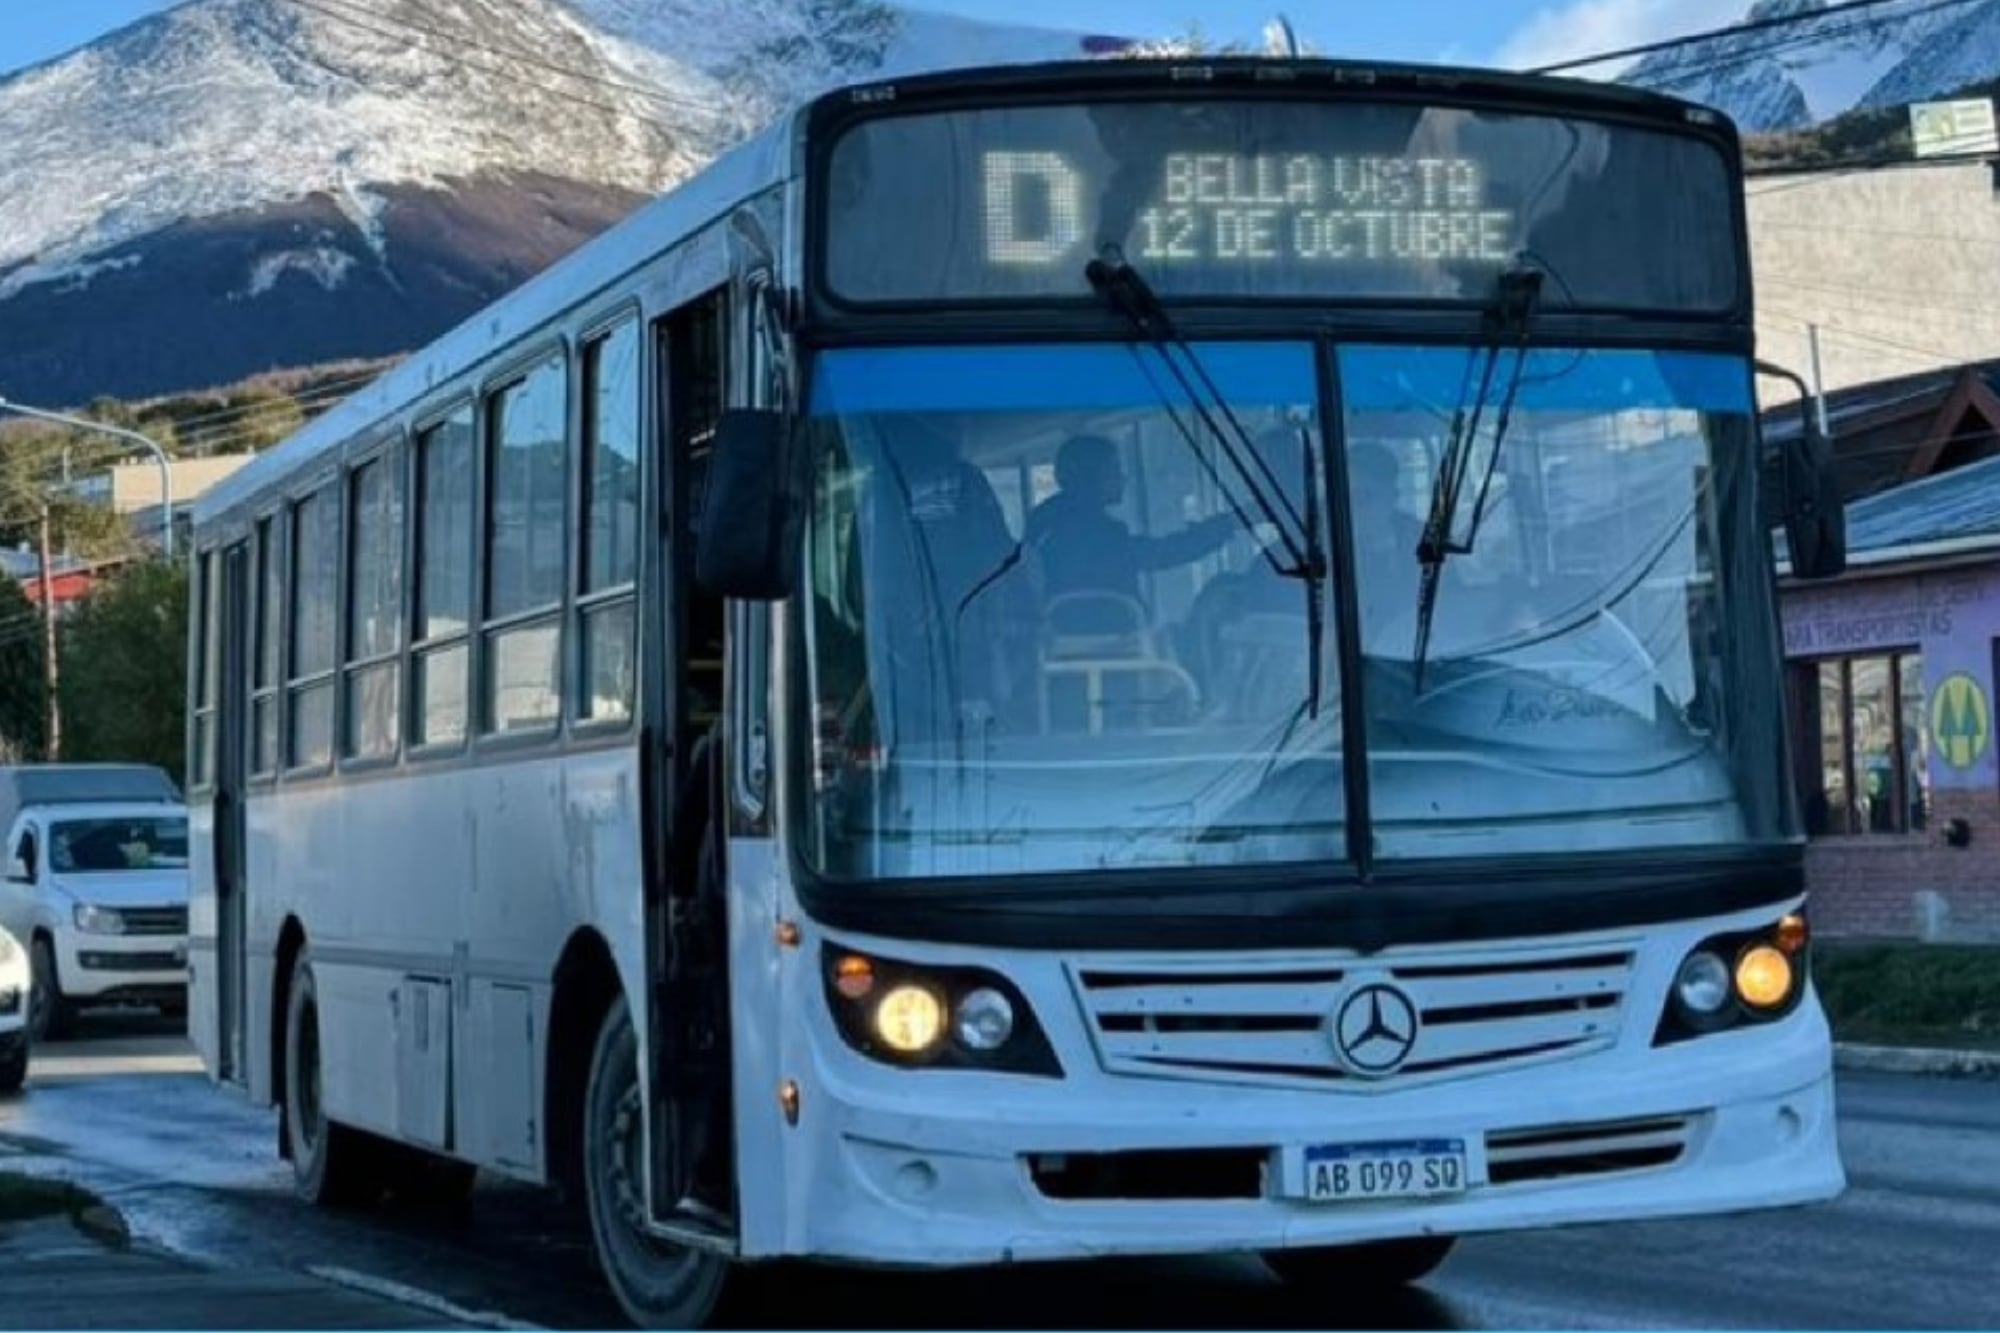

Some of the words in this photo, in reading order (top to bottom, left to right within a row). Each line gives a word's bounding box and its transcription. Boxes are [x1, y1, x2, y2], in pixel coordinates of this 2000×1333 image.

[983, 151, 1082, 262] D
[1166, 154, 1314, 204] BELLA
[1333, 156, 1477, 207] VISTA
[1141, 207, 1195, 258] 12
[1216, 208, 1276, 258] DE
[1294, 210, 1513, 260] OCTUBRE
[1315, 1163, 1350, 1196] AB
[1359, 1160, 1413, 1193] 099
